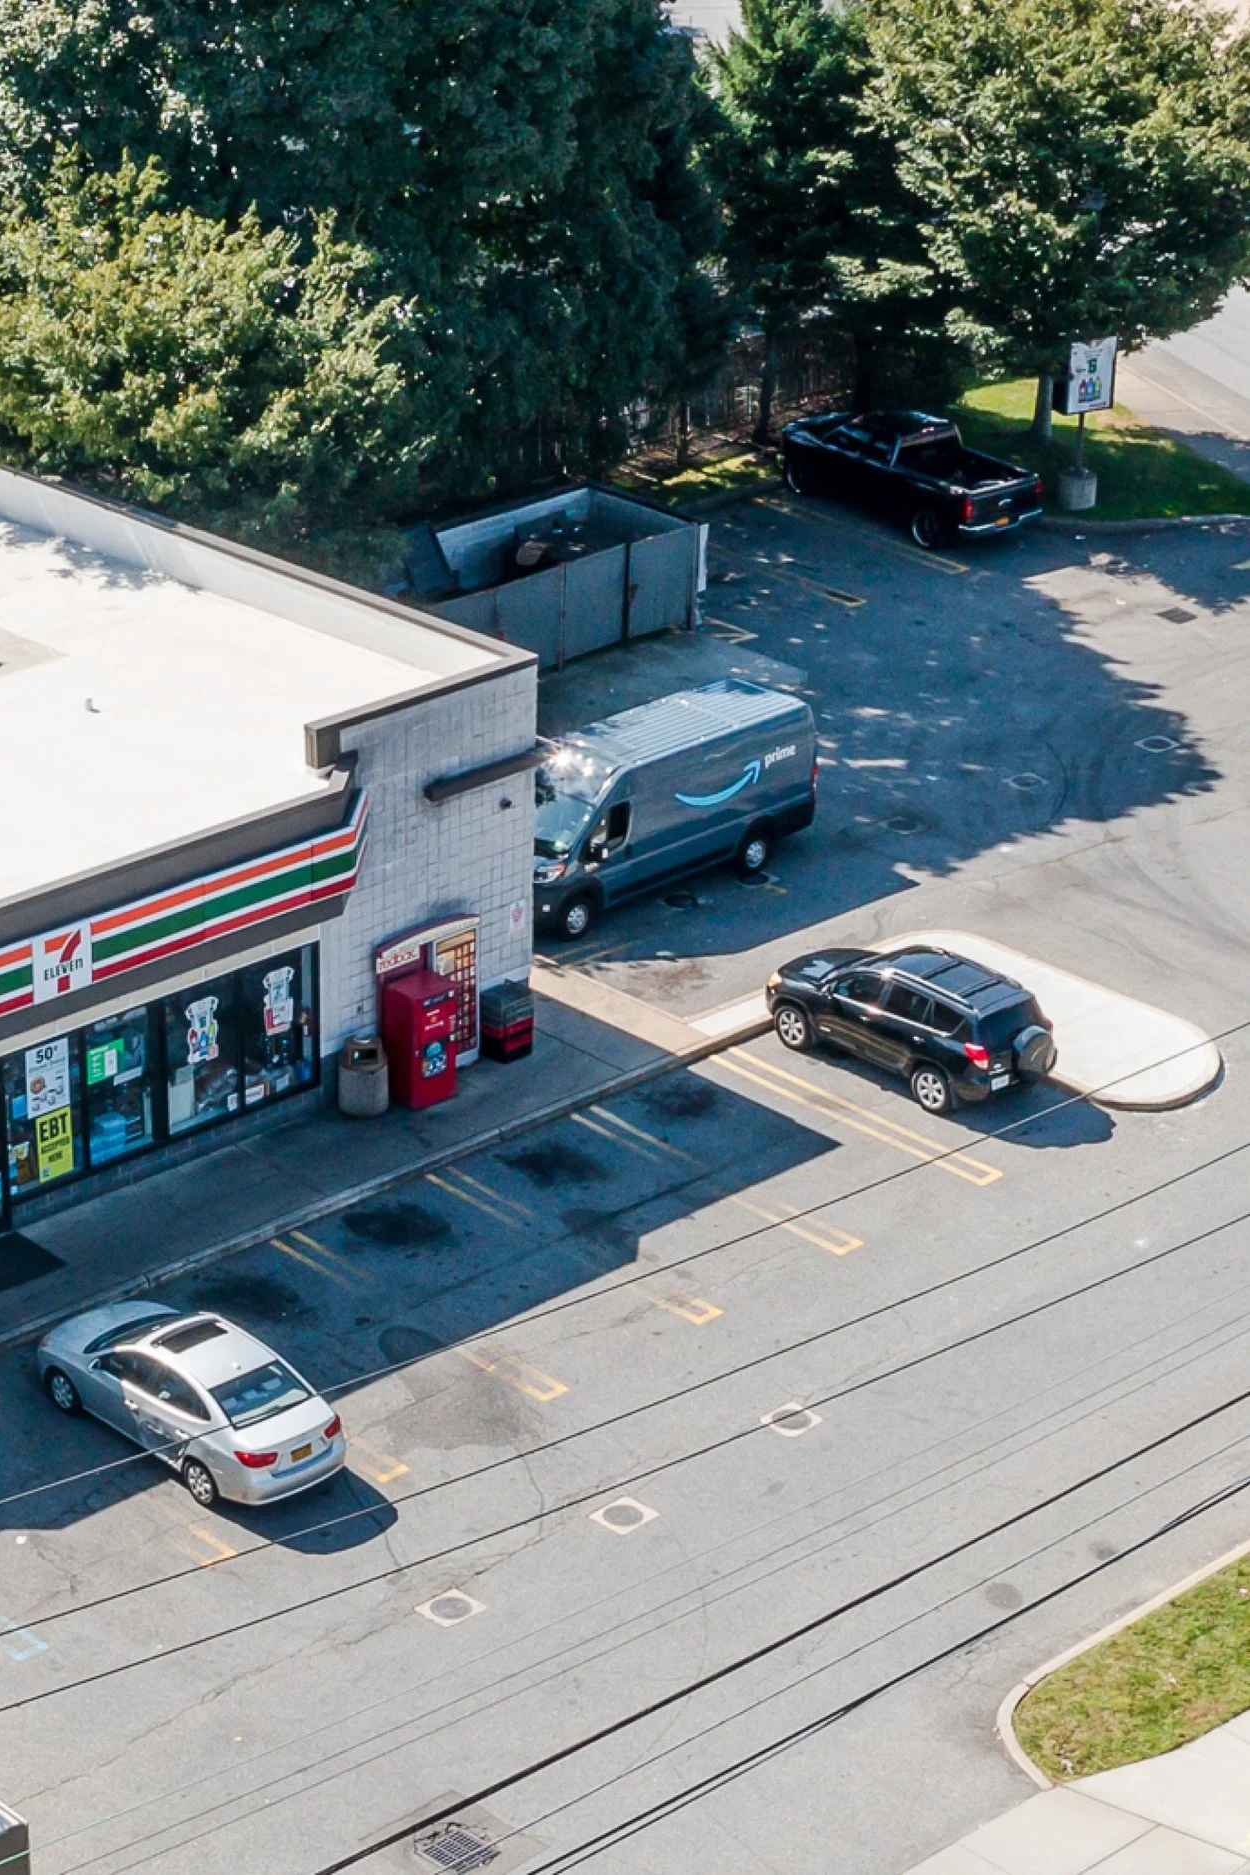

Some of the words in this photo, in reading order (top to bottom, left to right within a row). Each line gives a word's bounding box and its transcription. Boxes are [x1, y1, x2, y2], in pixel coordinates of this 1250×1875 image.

[765, 744, 796, 768] prime
[45, 927, 82, 993] 7
[39, 1112, 68, 1142] EBT
